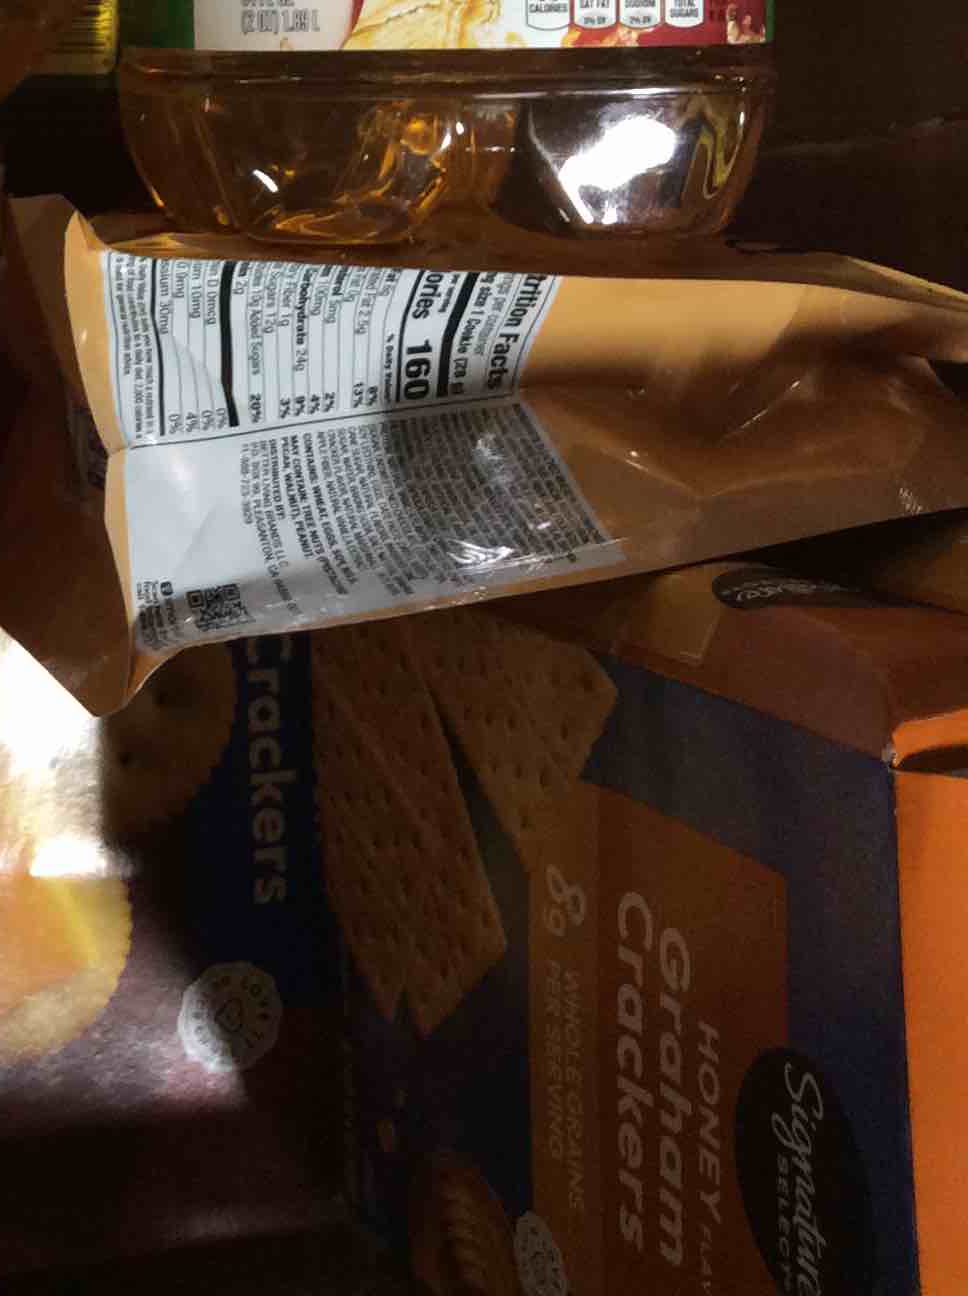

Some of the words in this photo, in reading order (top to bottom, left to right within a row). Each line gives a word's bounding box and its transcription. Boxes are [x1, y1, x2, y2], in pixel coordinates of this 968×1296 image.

[529, 3, 568, 14] CALORIES
[404, 339, 432, 400] 160
[458, 319, 480, 354] Cookie
[487, 333, 520, 389] Facts
[616, 892, 654, 1253] Crackers
[658, 928, 690, 1266] Graham
[698, 1021, 719, 1221] HONEY
[771, 1063, 824, 1296] Signature
